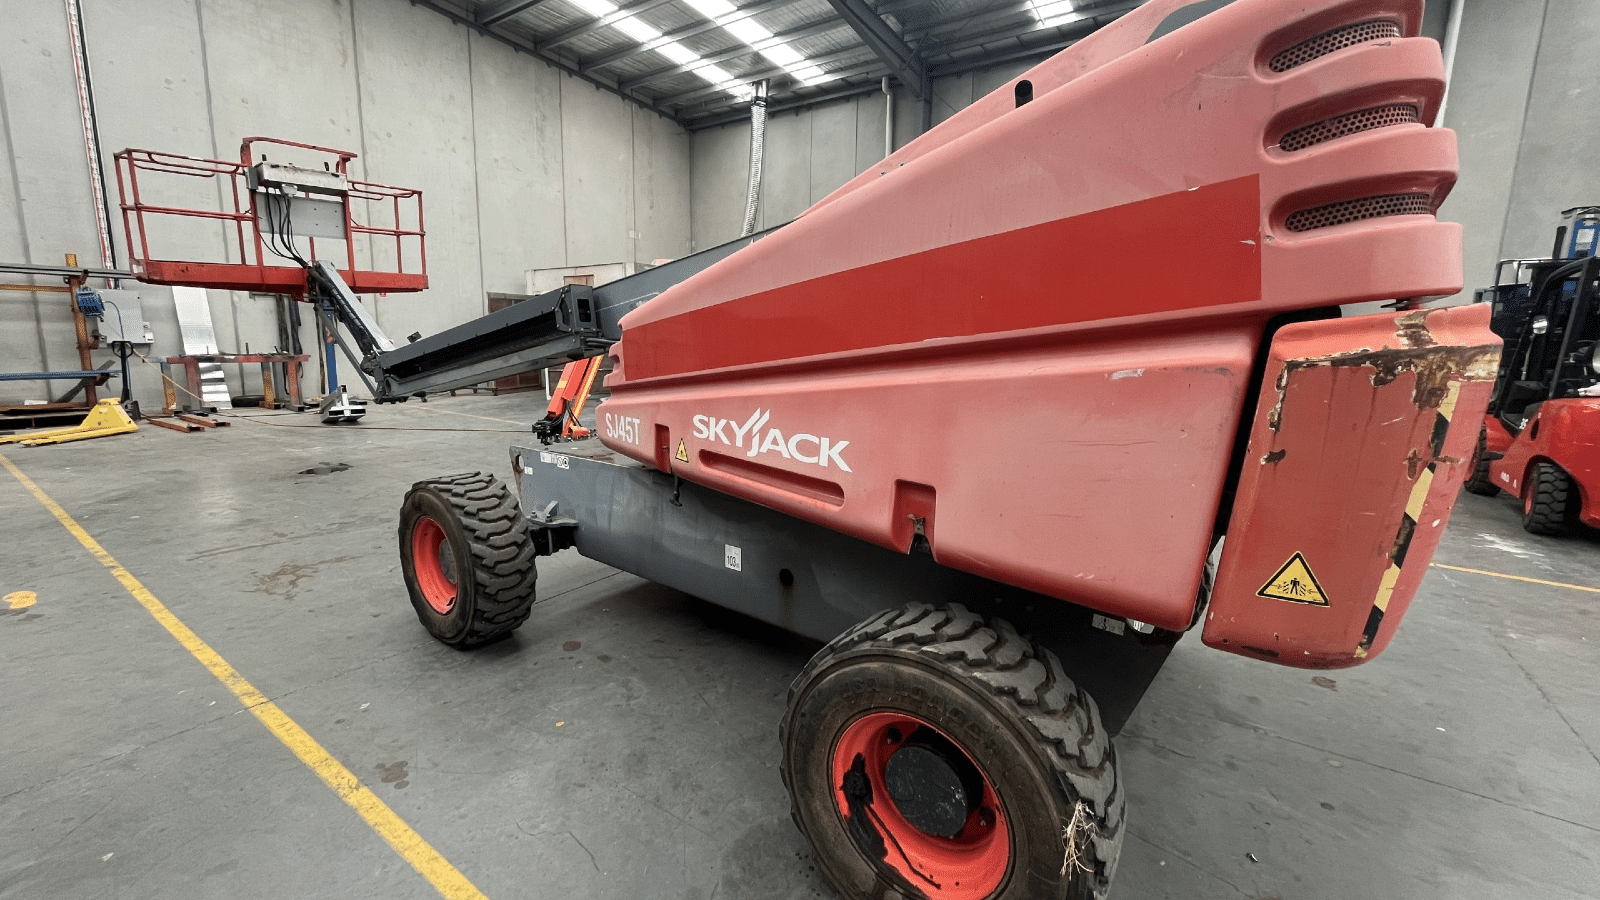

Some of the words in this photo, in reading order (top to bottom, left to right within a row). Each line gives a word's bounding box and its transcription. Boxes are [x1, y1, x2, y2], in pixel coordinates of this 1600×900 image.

[605, 412, 641, 445] SJ45T
[692, 407, 852, 473] SKYJACK
[727, 555, 737, 568] 103
